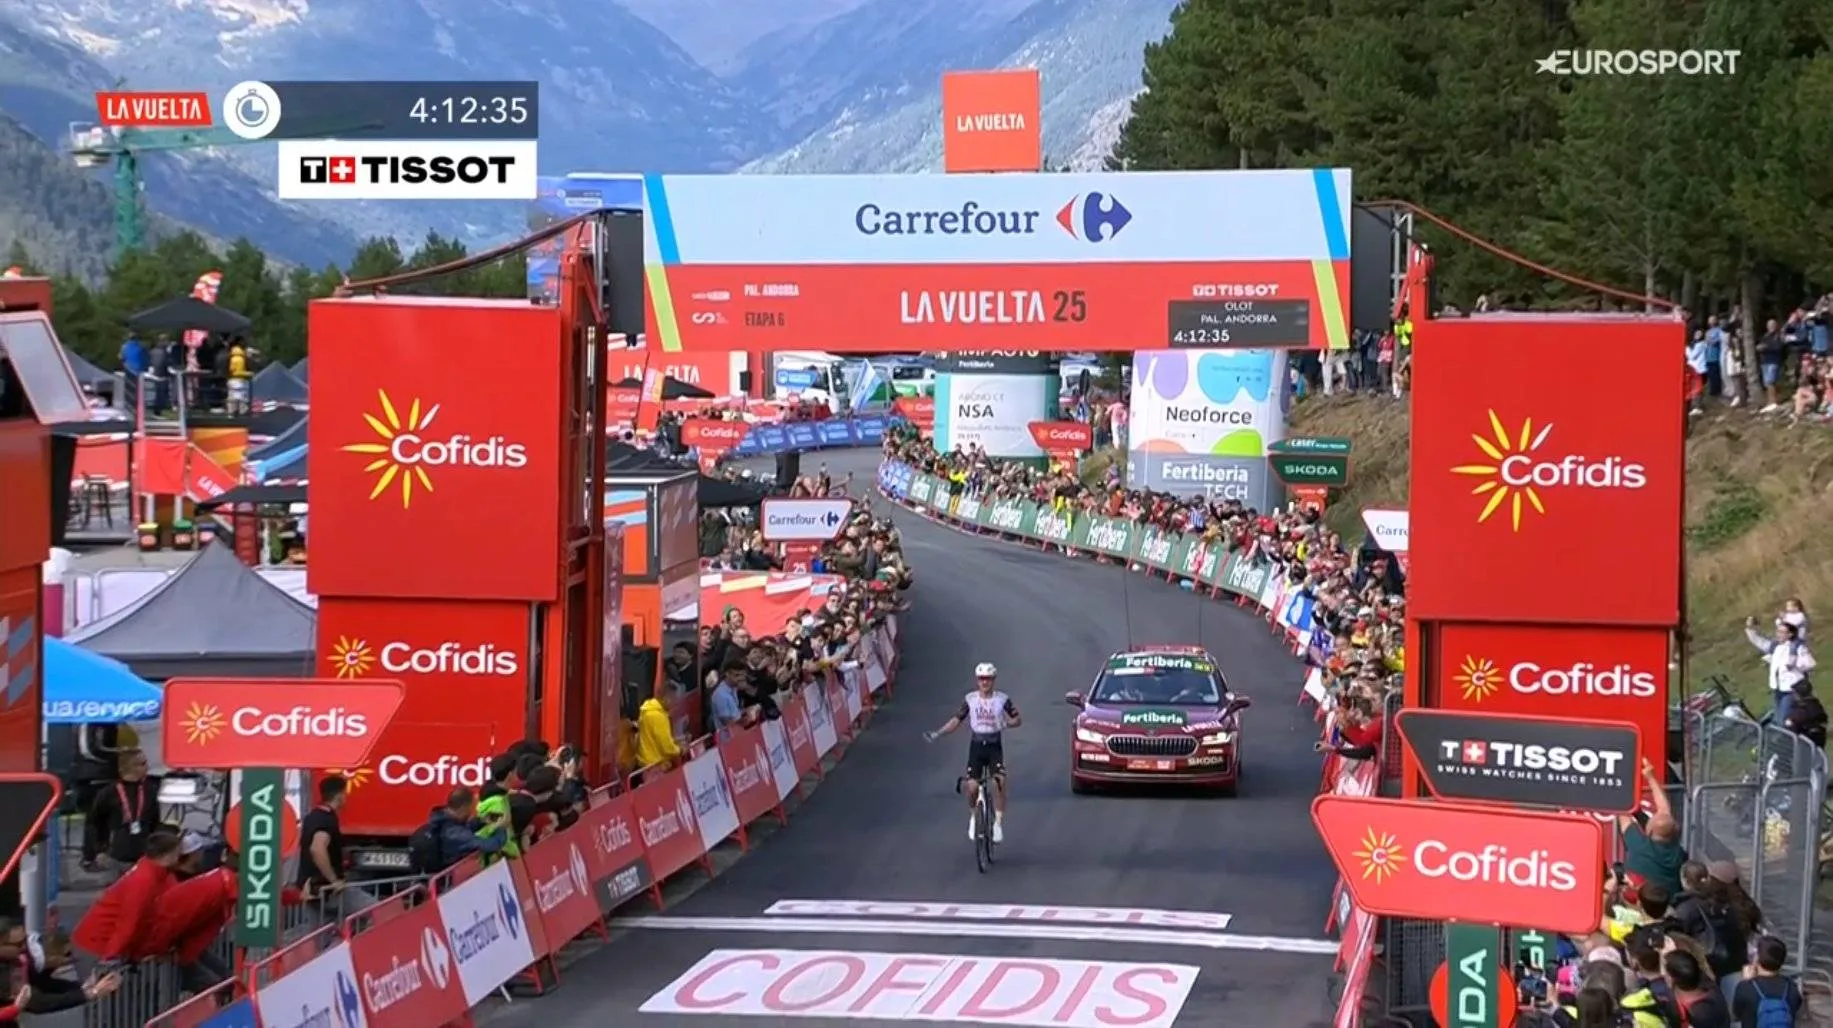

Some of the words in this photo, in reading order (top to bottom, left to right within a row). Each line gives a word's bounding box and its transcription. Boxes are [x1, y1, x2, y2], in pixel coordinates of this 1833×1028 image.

[957, 115, 974, 132] LA
[975, 113, 1025, 131] VUELTA
[855, 200, 1040, 235] Carrefour
[1217, 283, 1279, 297] TISSOT
[900, 290, 935, 323] LA
[937, 290, 1046, 323] VUELTA
[1052, 291, 1087, 322] 25
[1224, 301, 1253, 312] OLOT
[745, 312, 775, 326] ETAPA
[777, 313, 785, 326] 6
[1225, 314, 1278, 324] ANDORRA
[1173, 329, 1231, 343] 4:12:35
[958, 404, 995, 419] NSA
[1166, 406, 1252, 425] Neoforce
[391, 434, 528, 468] Cofidis
[1161, 461, 1249, 483] Fertiberia
[1501, 455, 1647, 488] Cofidis
[1204, 484, 1249, 500] TECH
[768, 514, 817, 526] Carrefour
[380, 642, 518, 674] Cofidis
[1126, 656, 1193, 669] Fertiberia
[1509, 662, 1656, 696] Cofidis
[43, 700, 159, 717] uaservice
[1123, 712, 1184, 724] Fertiberia
[232, 706, 368, 737] Cofidis
[1490, 741, 1624, 774] TISSOT
[379, 755, 494, 786] Cofidi
[1437, 764, 1477, 776] SWISS
[1483, 767, 1541, 781] WATCHES
[1548, 772, 1587, 785] SINCE
[1413, 839, 1577, 891] Cofidis
[449, 910, 499, 965] Carrefour
[362, 955, 422, 1014] Carrefour
[673, 953, 1180, 1026] COFIDIS
